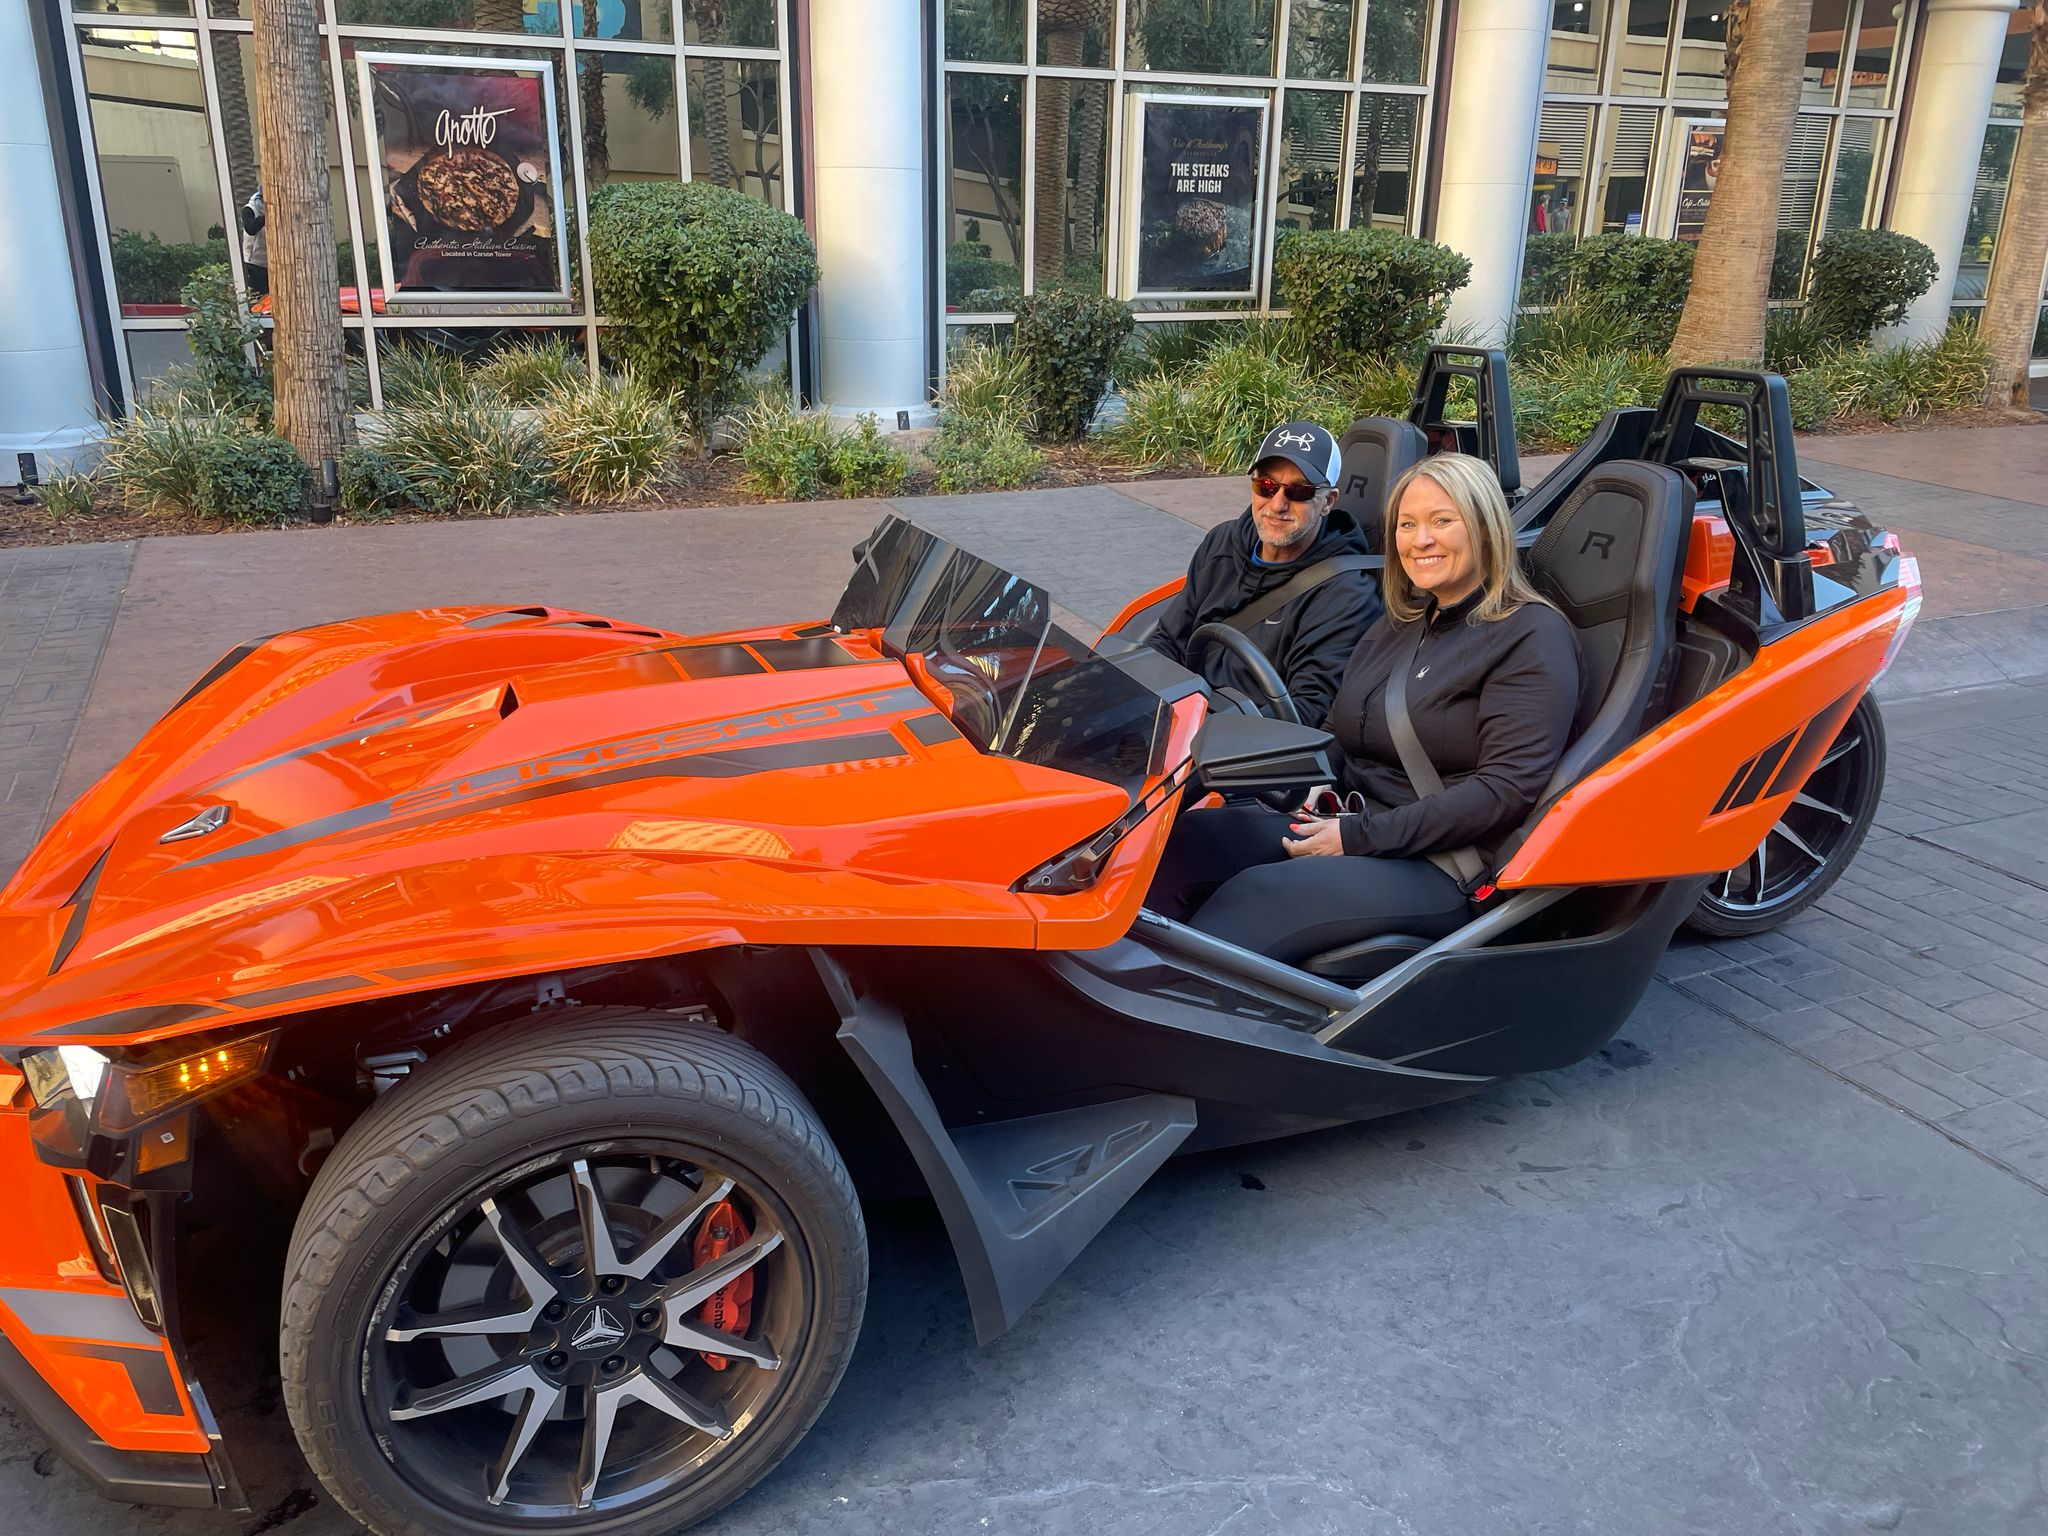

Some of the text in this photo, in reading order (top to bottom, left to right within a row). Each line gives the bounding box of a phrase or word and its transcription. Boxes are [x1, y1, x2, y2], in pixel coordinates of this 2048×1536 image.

[1171, 163, 1230, 178] THE STEAKS
[1176, 179, 1222, 193] ARE HIGH
[413, 236, 537, 251] Authentic Italian Cuisine
[473, 250, 494, 258] Carson
[1345, 474, 1368, 498] R
[1578, 531, 1616, 559] R
[390, 694, 893, 812] SLINGSHOT
[714, 1287, 729, 1330] bremb
